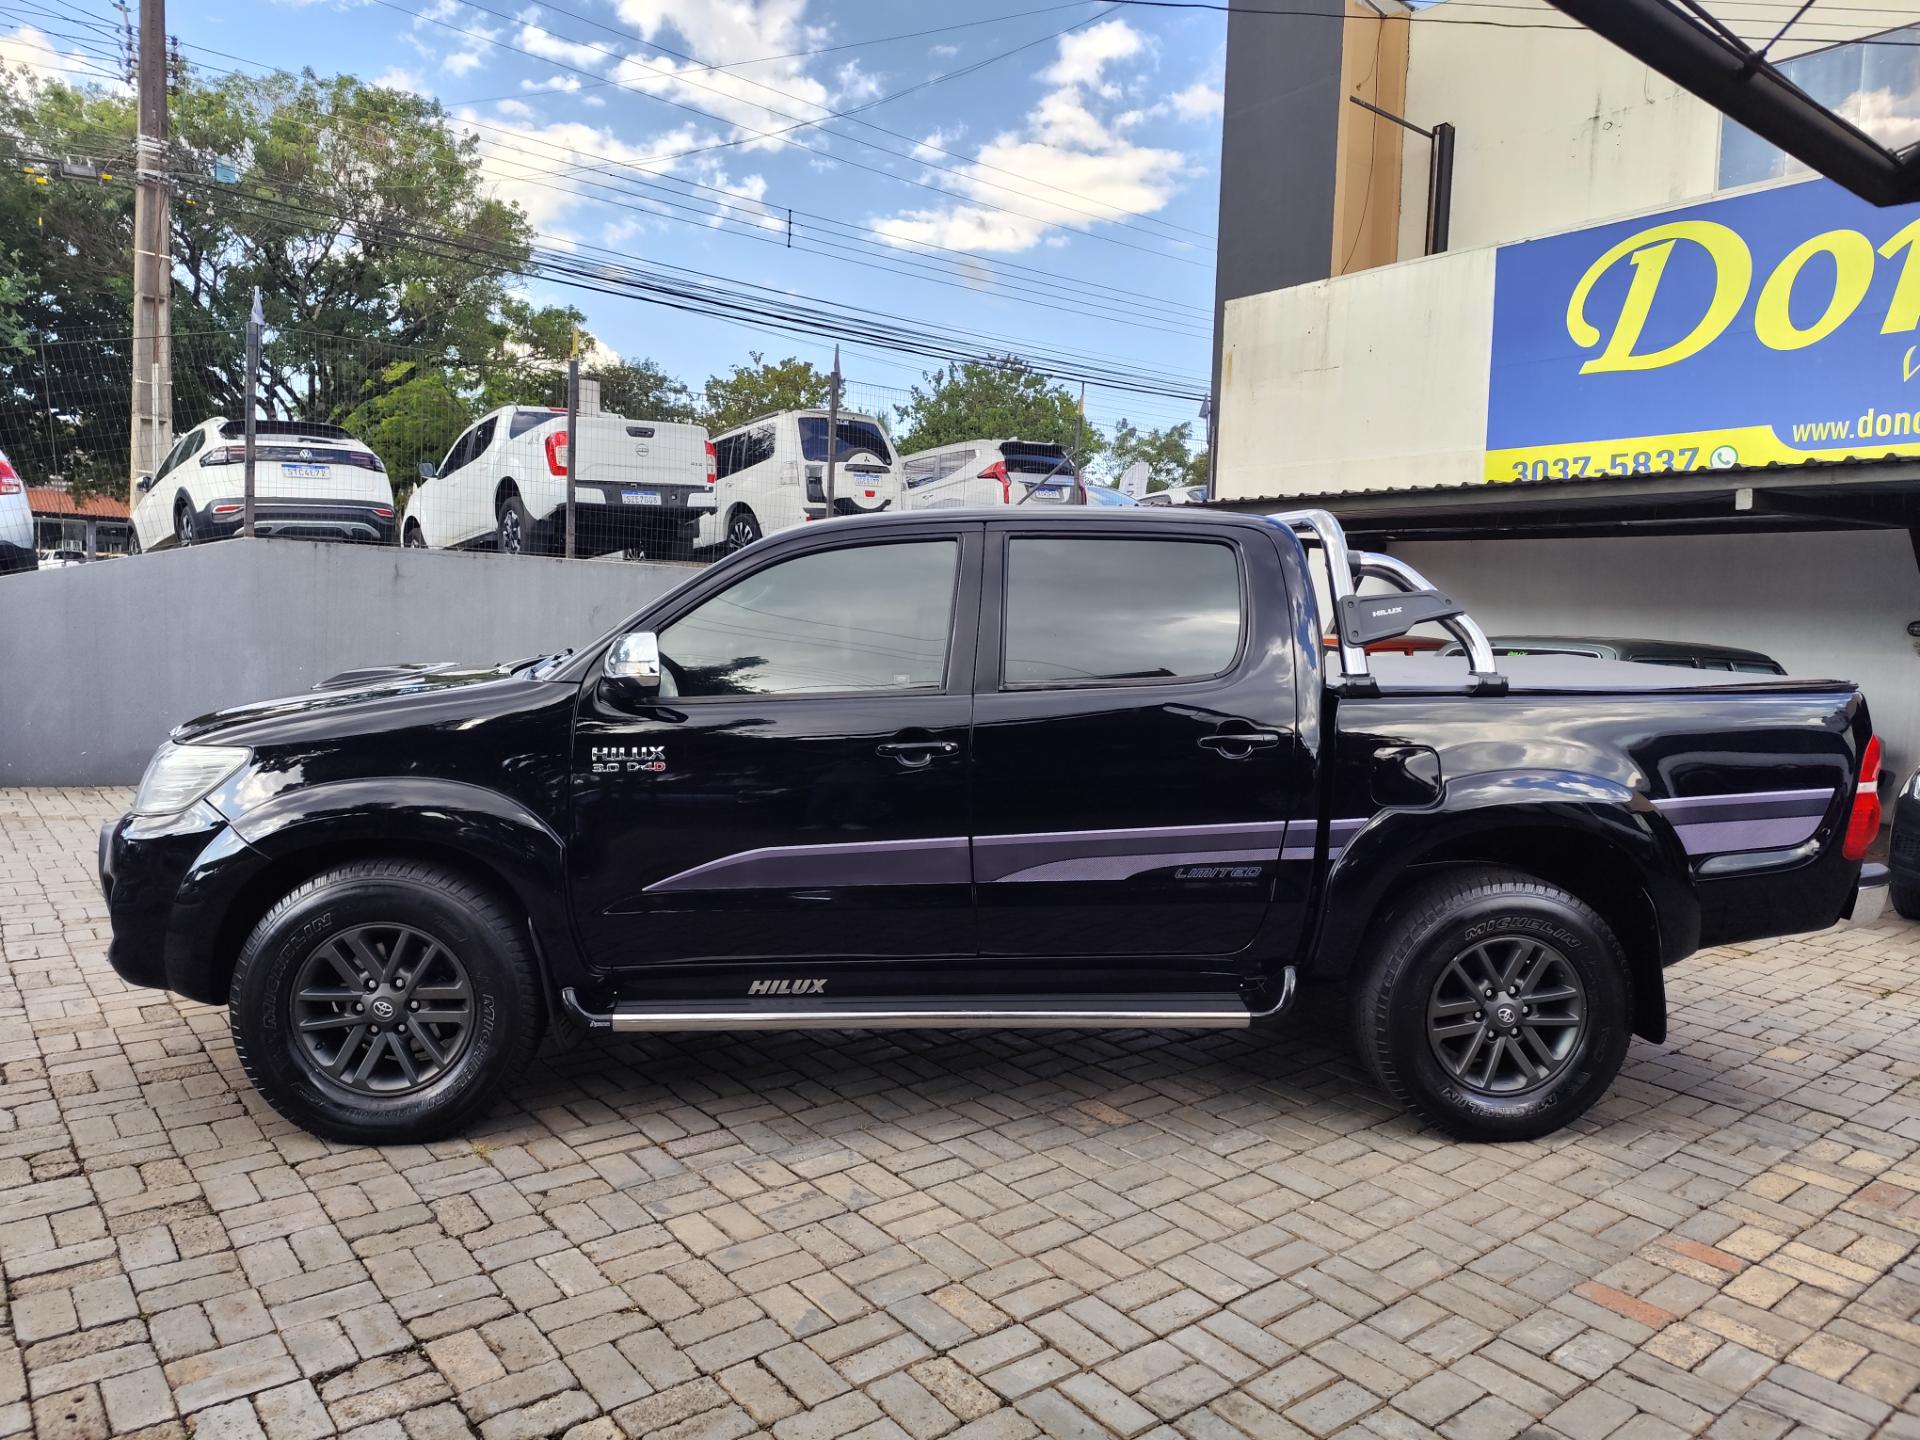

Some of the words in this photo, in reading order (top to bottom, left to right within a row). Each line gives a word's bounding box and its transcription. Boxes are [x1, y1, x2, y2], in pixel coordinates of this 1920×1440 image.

[1512, 447, 1700, 481] 3037-5837
[1372, 606, 1403, 617] HILUX
[591, 746, 666, 761] HILUX
[591, 762, 620, 773] 3.0
[1174, 866, 1262, 879] LIMITED
[1464, 917, 1581, 948] MICHELIN
[747, 978, 828, 995] HILUX
